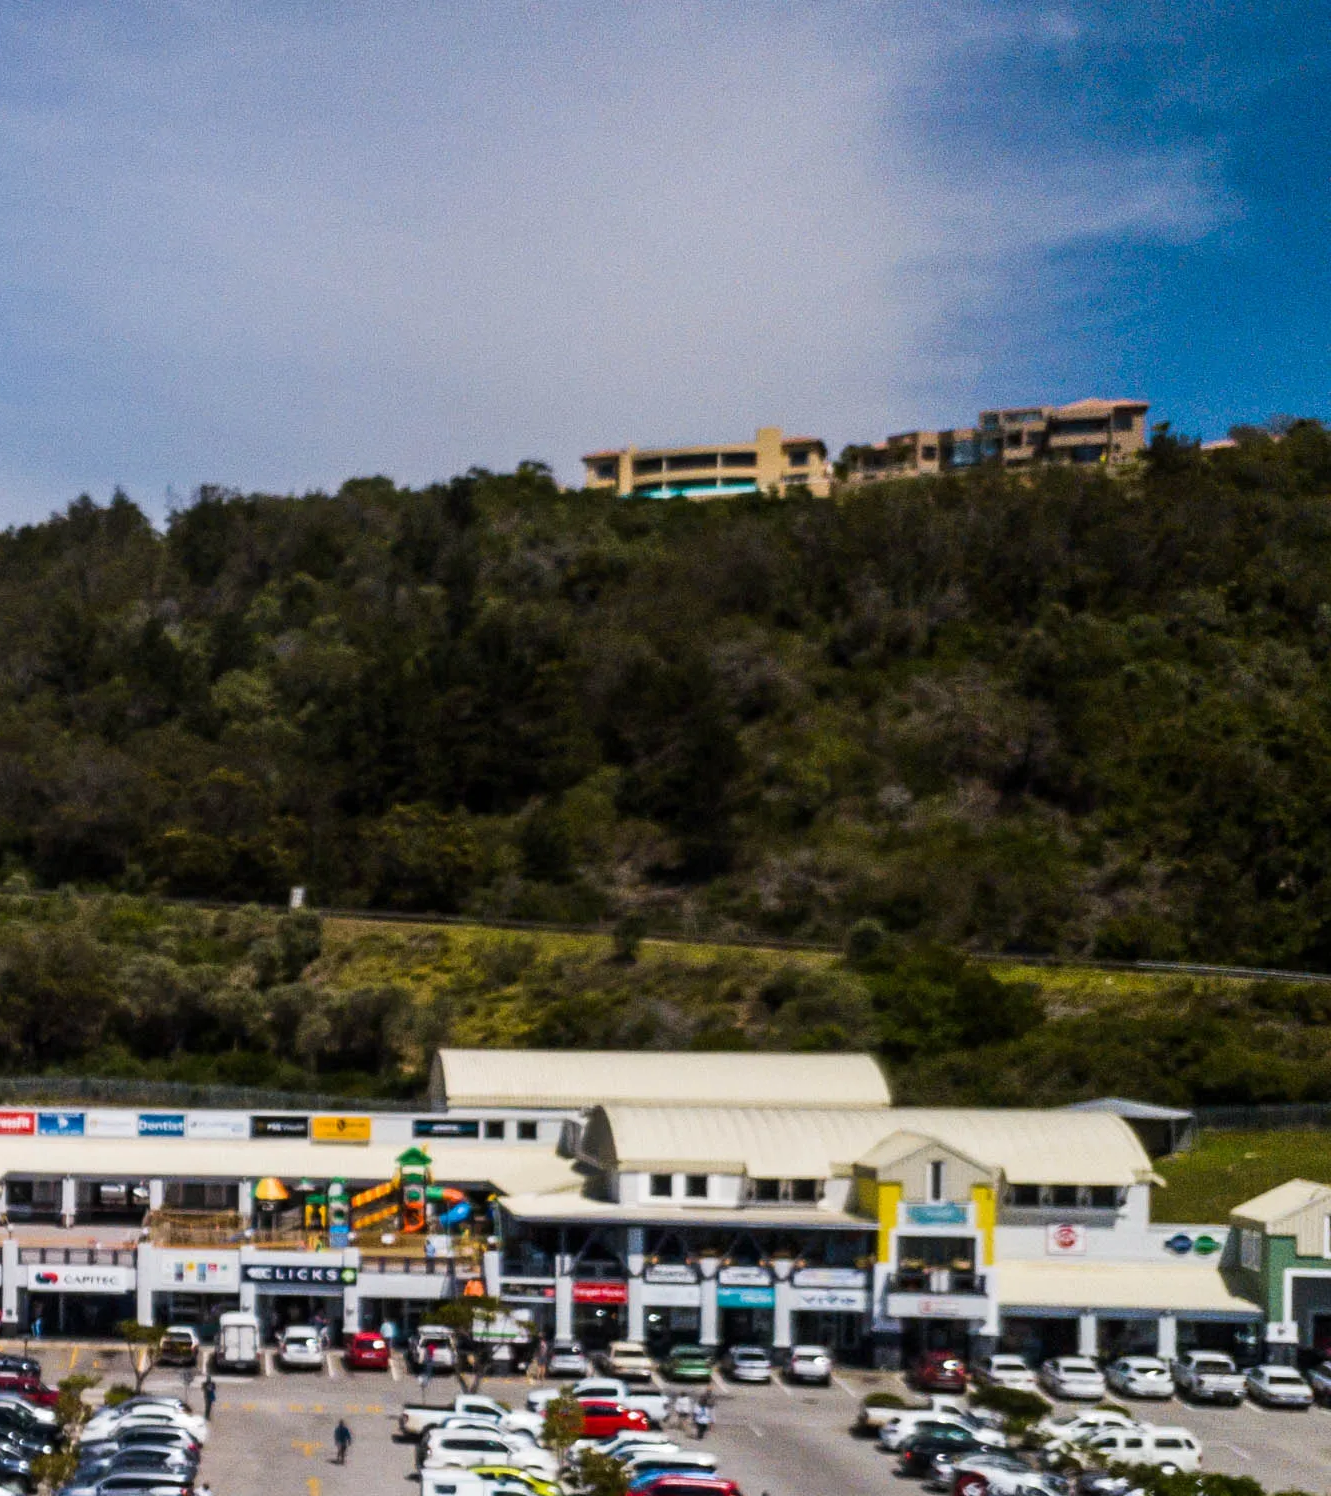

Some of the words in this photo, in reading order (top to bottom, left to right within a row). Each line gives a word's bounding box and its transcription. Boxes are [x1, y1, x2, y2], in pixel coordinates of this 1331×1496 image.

[139, 1120, 185, 1132] Dentist
[63, 1273, 117, 1285] CAPITEC
[261, 1268, 338, 1281] CLICKS
